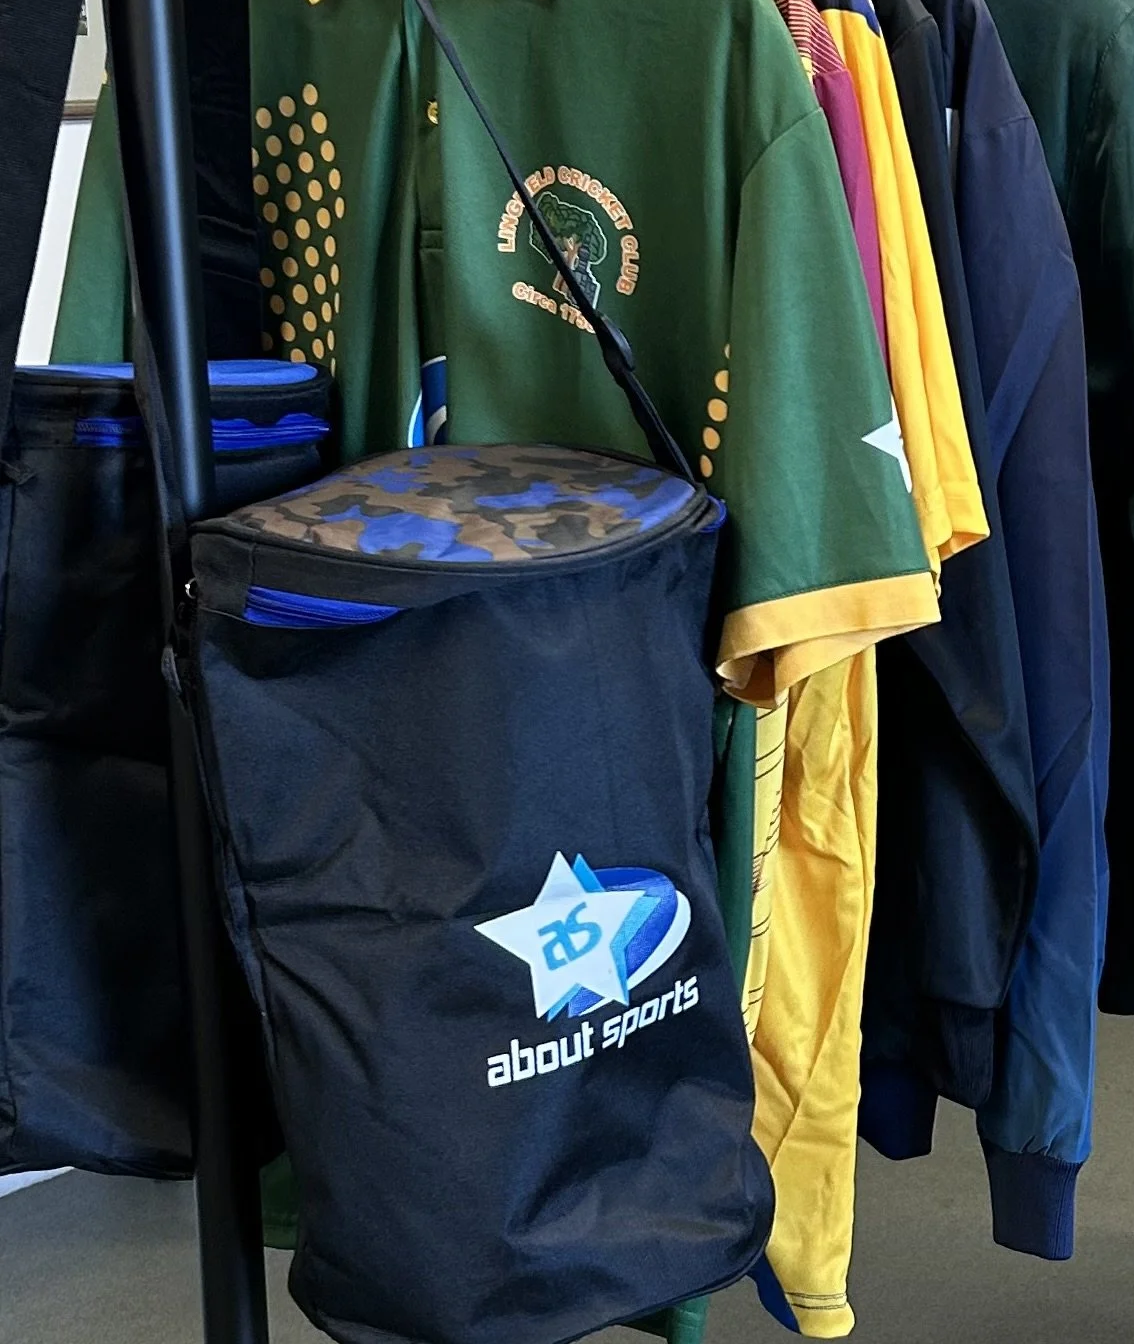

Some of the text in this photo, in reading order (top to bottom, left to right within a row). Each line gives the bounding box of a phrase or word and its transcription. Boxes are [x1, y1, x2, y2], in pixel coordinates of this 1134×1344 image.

[498, 165, 640, 296] LINGELD CRICKET CLUB
[511, 281, 558, 315] Circa
[537, 901, 603, 972] as
[487, 975, 699, 1088] about sports
